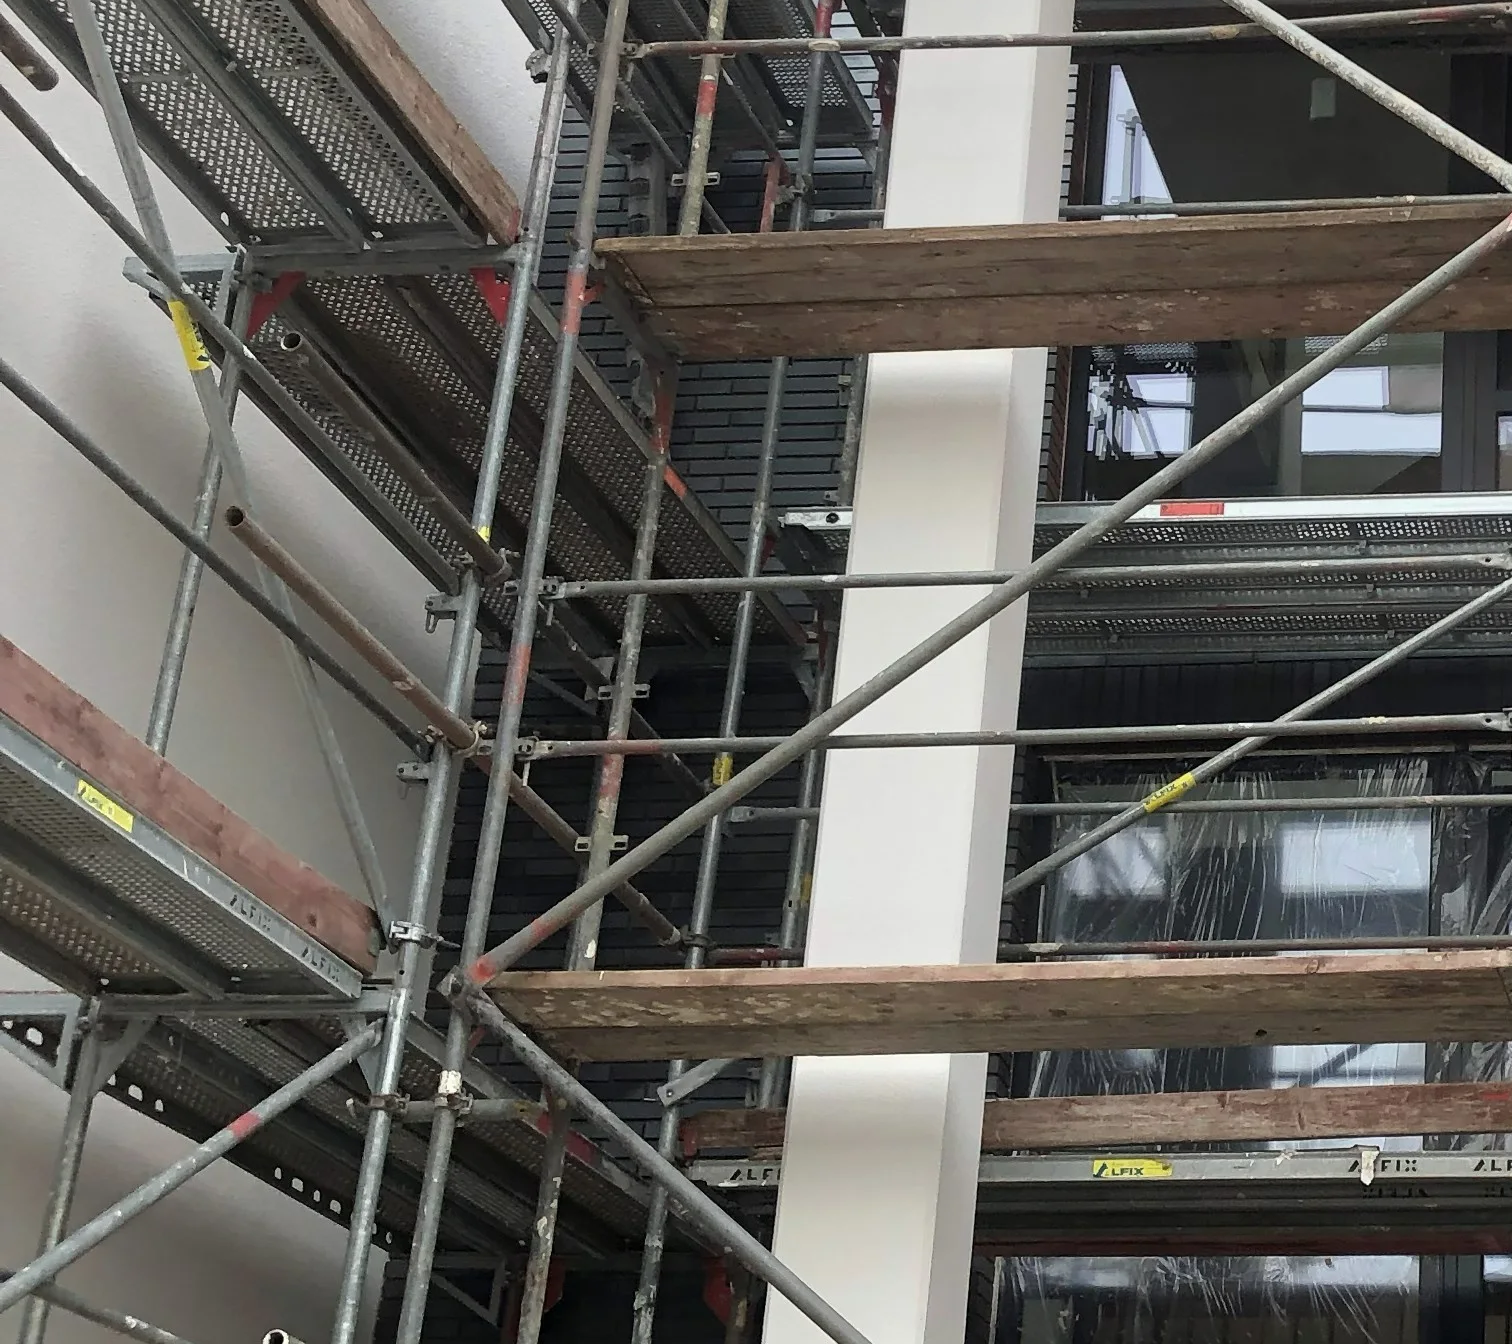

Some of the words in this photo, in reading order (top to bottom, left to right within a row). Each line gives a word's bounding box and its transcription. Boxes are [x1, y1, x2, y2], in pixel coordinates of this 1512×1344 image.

[230, 895, 272, 933] ALFIX
[729, 1167, 781, 1181] ALFI
[1092, 1161, 1144, 1179] ALFIX
[1347, 1159, 1418, 1173] AFIX
